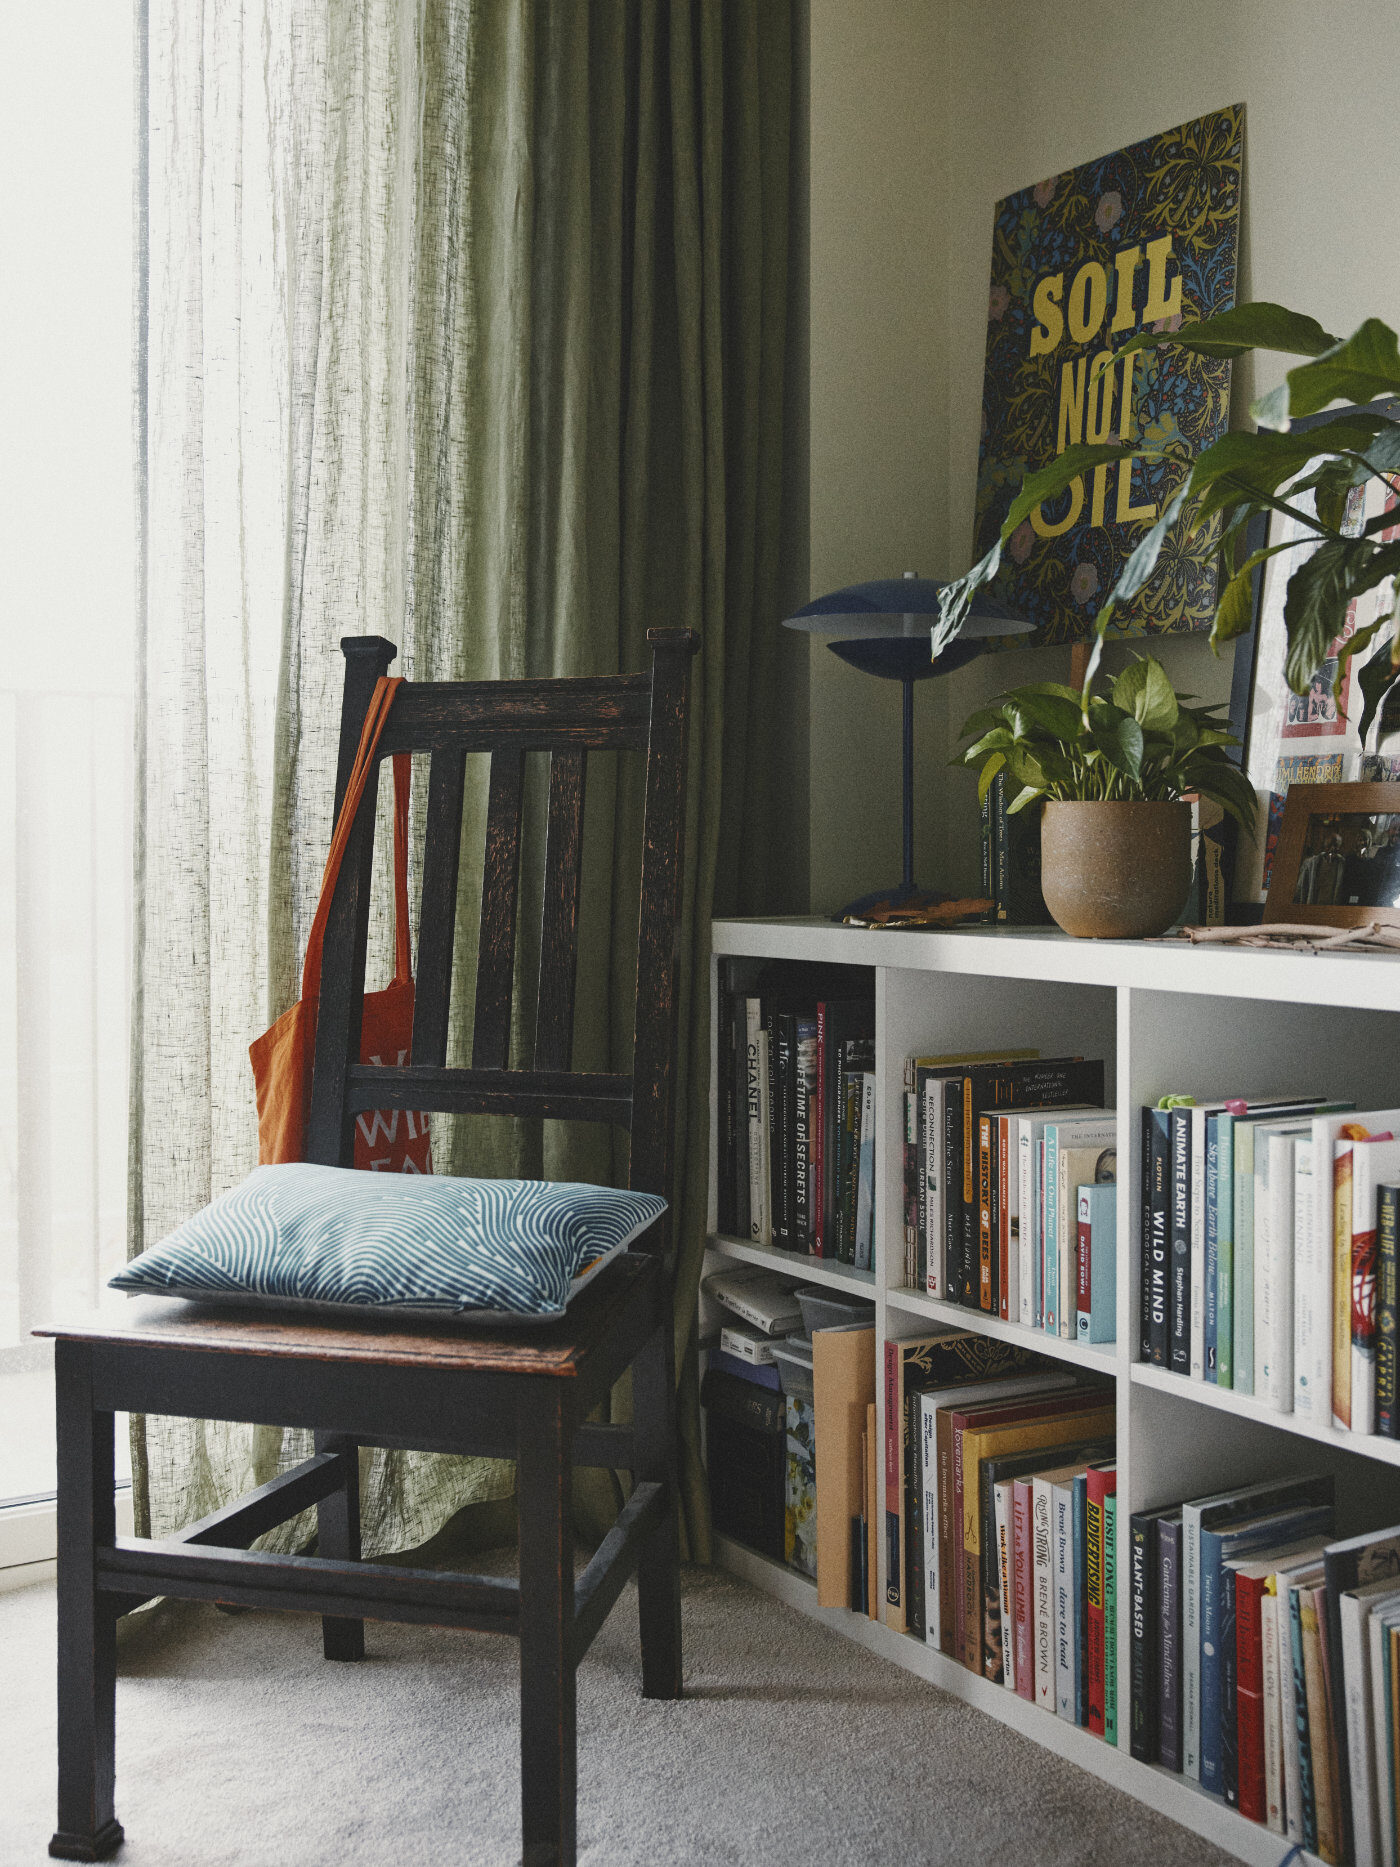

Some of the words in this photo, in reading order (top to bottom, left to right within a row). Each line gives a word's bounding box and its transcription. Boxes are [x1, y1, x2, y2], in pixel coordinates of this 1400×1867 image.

[1030, 233, 1184, 358] SOIL
[1056, 344, 1144, 454] NOT
[747, 1043, 758, 1122] CHANEL
[796, 1054, 806, 1119] LIFETIME
[796, 1122, 806, 1142] OF
[946, 1106, 954, 1137] Under
[981, 1123, 989, 1148] THE
[946, 1140, 954, 1157] the
[1047, 1136, 1055, 1146] A
[1047, 1147, 1056, 1168] Life
[1176, 1116, 1187, 1180] ANIMATE
[1208, 1142, 1219, 1163] Sky
[796, 1143, 806, 1204] SECRETS
[946, 1159, 954, 1185] Stars
[981, 1150, 989, 1207] HISTORY
[1192, 1177, 1202, 1203] Steps
[1208, 1164, 1218, 1199] Above
[1047, 1185, 1055, 1206] Our
[1176, 1182, 1186, 1228] EARTH
[981, 1209, 989, 1229] OF
[1048, 1207, 1056, 1239] Planet
[1153, 1211, 1165, 1262] WILD
[1208, 1204, 1219, 1238] Earth
[981, 1231, 989, 1261] BEES
[1208, 1240, 1218, 1276] Below
[1381, 1234, 1395, 1256] LIFE
[1153, 1268, 1164, 1324] MIND
[1175, 1266, 1184, 1302] Stephan
[1175, 1303, 1184, 1337] Harding
[1378, 1342, 1387, 1397] CAPRA
[887, 1377, 895, 1431] Management
[954, 1427, 965, 1494] lovemarks
[941, 1467, 949, 1512] lovemarks
[1014, 1500, 1025, 1532] LIFT
[1035, 1494, 1050, 1527] RISING
[1058, 1502, 1067, 1536] Brené
[1035, 1526, 1050, 1568] STRONG
[1105, 1509, 1114, 1551] JOSIE
[1015, 1550, 1025, 1579] YOU
[1058, 1537, 1066, 1574] Brown
[1088, 1500, 1101, 1606] BADVERTISING
[1105, 1552, 1114, 1596] LONG
[1133, 1545, 1143, 1639] PLANT-BASED
[1161, 1556, 1173, 1617] Gardening
[1205, 1573, 1213, 1603] Twelve
[1016, 1580, 1026, 1623] CLIMB
[1039, 1576, 1050, 1618] BRENÉ
[1059, 1586, 1068, 1620] dare
[1059, 1621, 1067, 1636] to
[1205, 1605, 1213, 1636] Moons
[1039, 1621, 1048, 1674] BROWN
[1060, 1637, 1069, 1670] lead
[1265, 1616, 1274, 1665] RADICAL
[1163, 1630, 1173, 1699] Mindfulness
